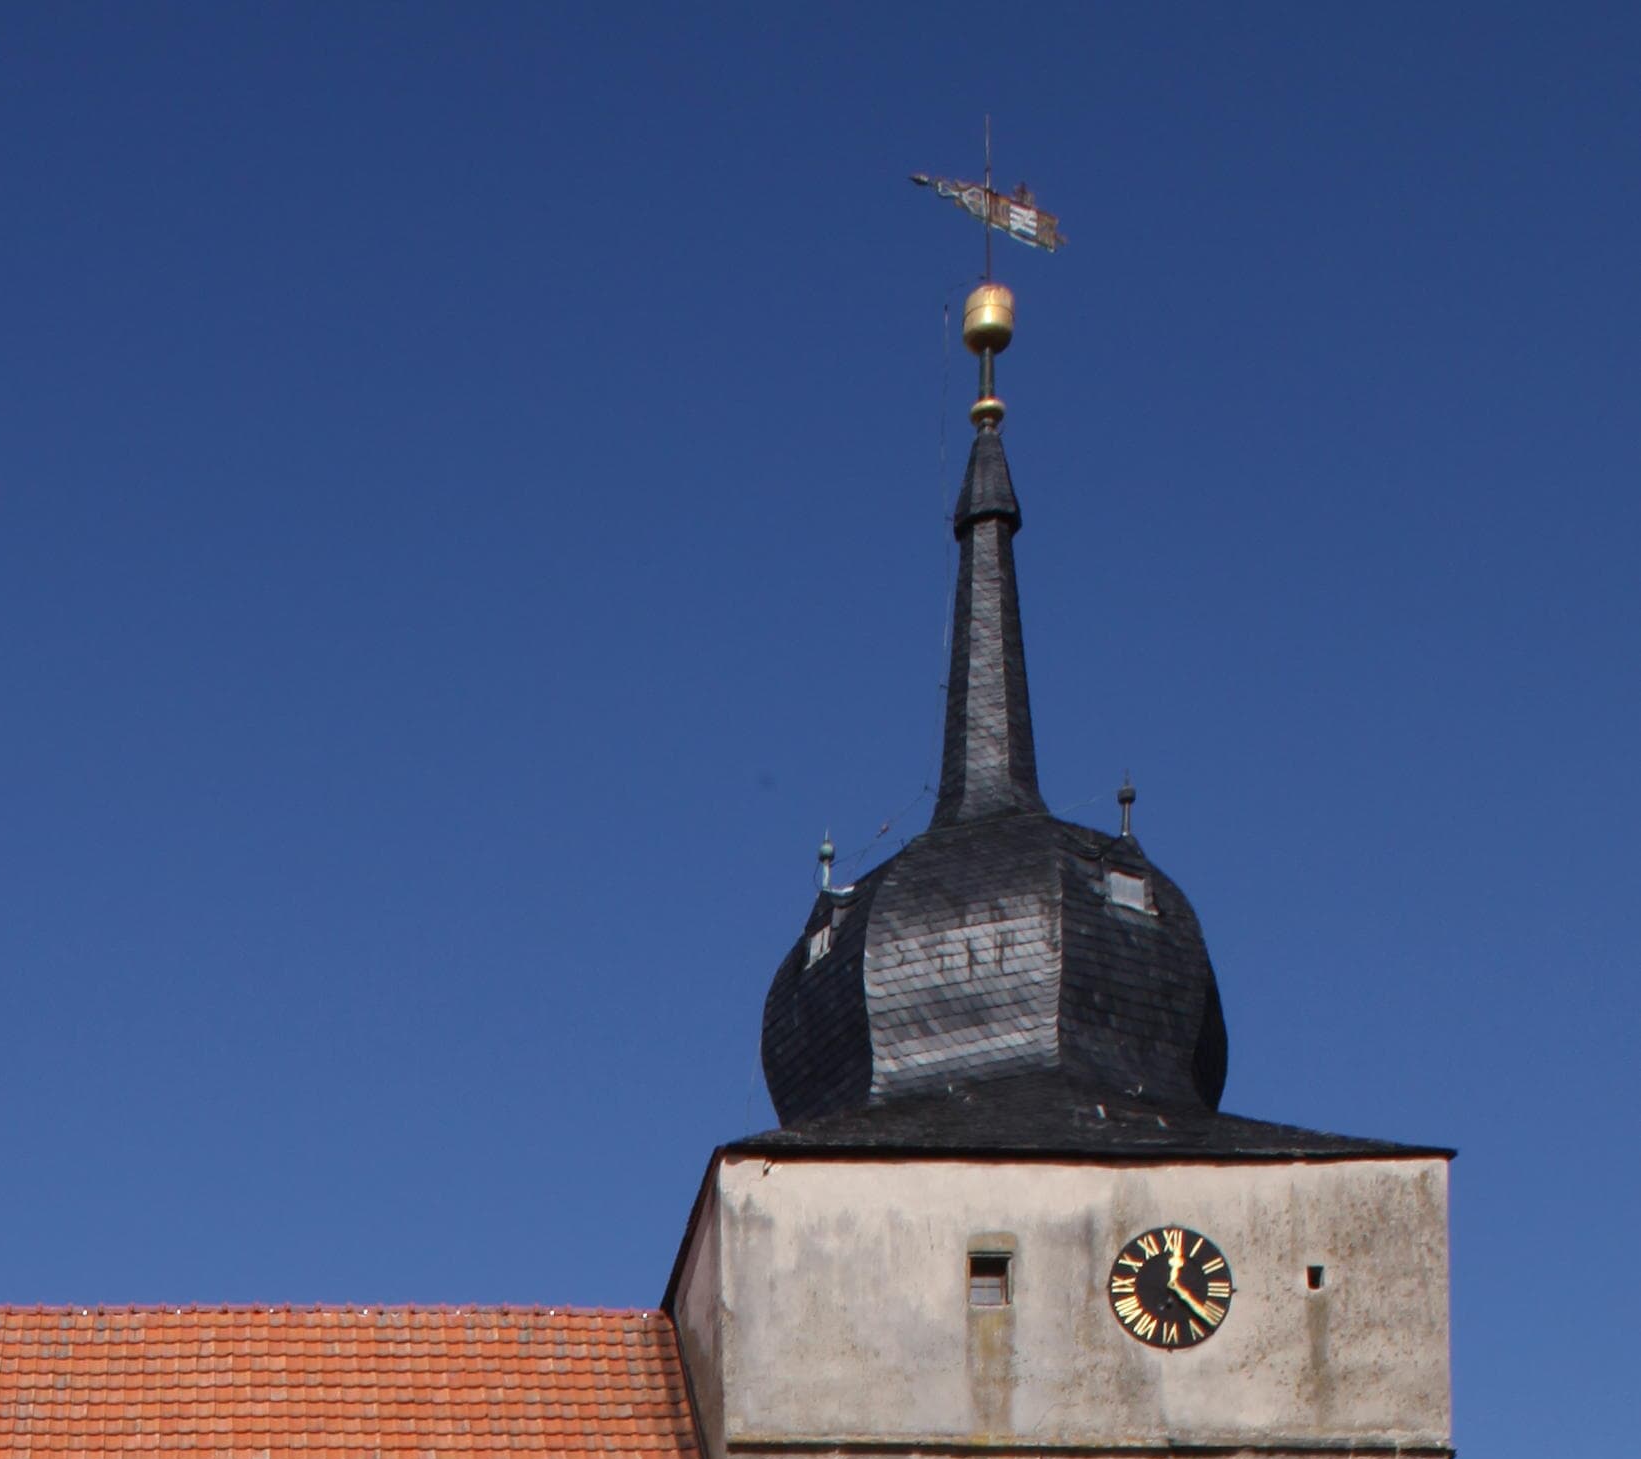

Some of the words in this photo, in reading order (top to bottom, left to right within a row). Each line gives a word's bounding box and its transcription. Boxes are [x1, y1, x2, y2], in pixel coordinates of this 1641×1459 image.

[1137, 1234, 1159, 1259] XI
[1190, 1237, 1204, 1258] I
[1118, 1254, 1143, 1272] X
[1202, 1257, 1224, 1274] II
[1112, 1276, 1136, 1293] IX
[1207, 1282, 1230, 1297] III
[1163, 1322, 1178, 1344] VI
[1188, 1319, 1204, 1341] V
